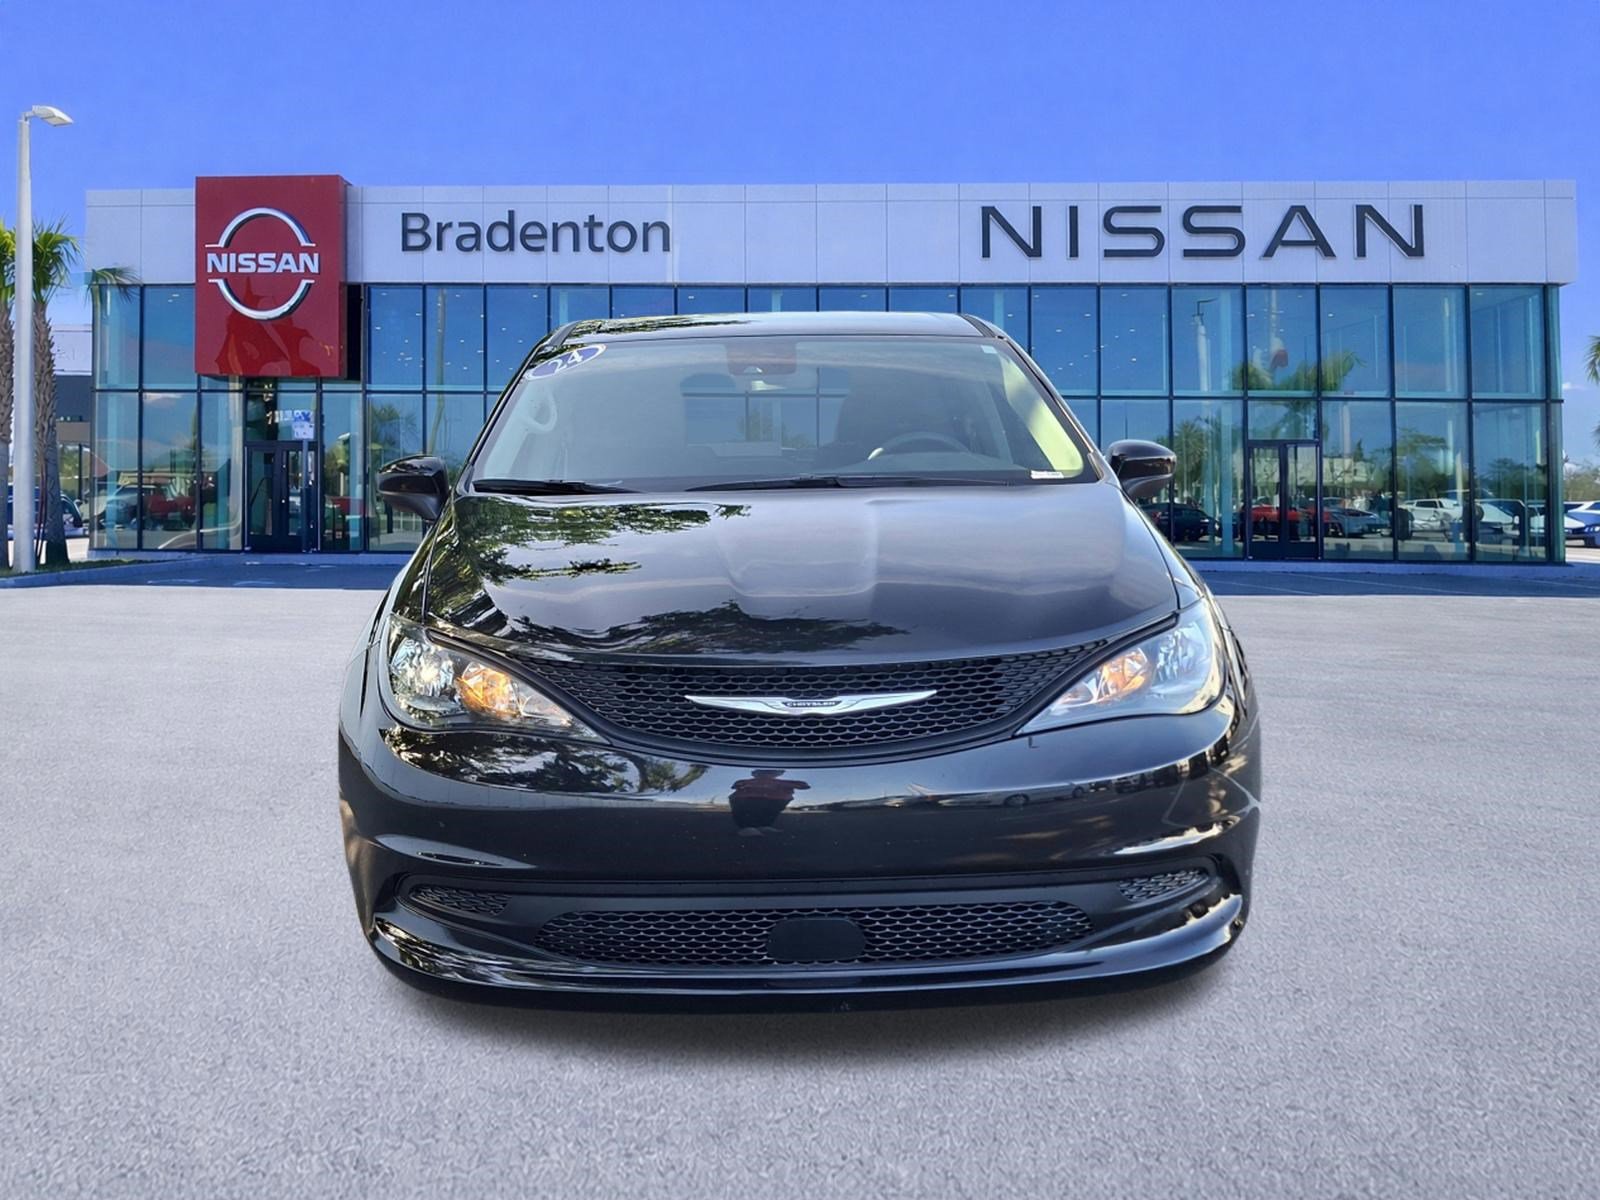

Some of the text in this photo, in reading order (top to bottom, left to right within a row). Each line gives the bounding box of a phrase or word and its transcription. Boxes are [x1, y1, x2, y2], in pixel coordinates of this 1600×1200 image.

[401, 209, 671, 252] Bradenton
[981, 204, 1425, 259] NISSAN
[207, 253, 319, 273] NISSAN
[548, 350, 584, 374] 24
